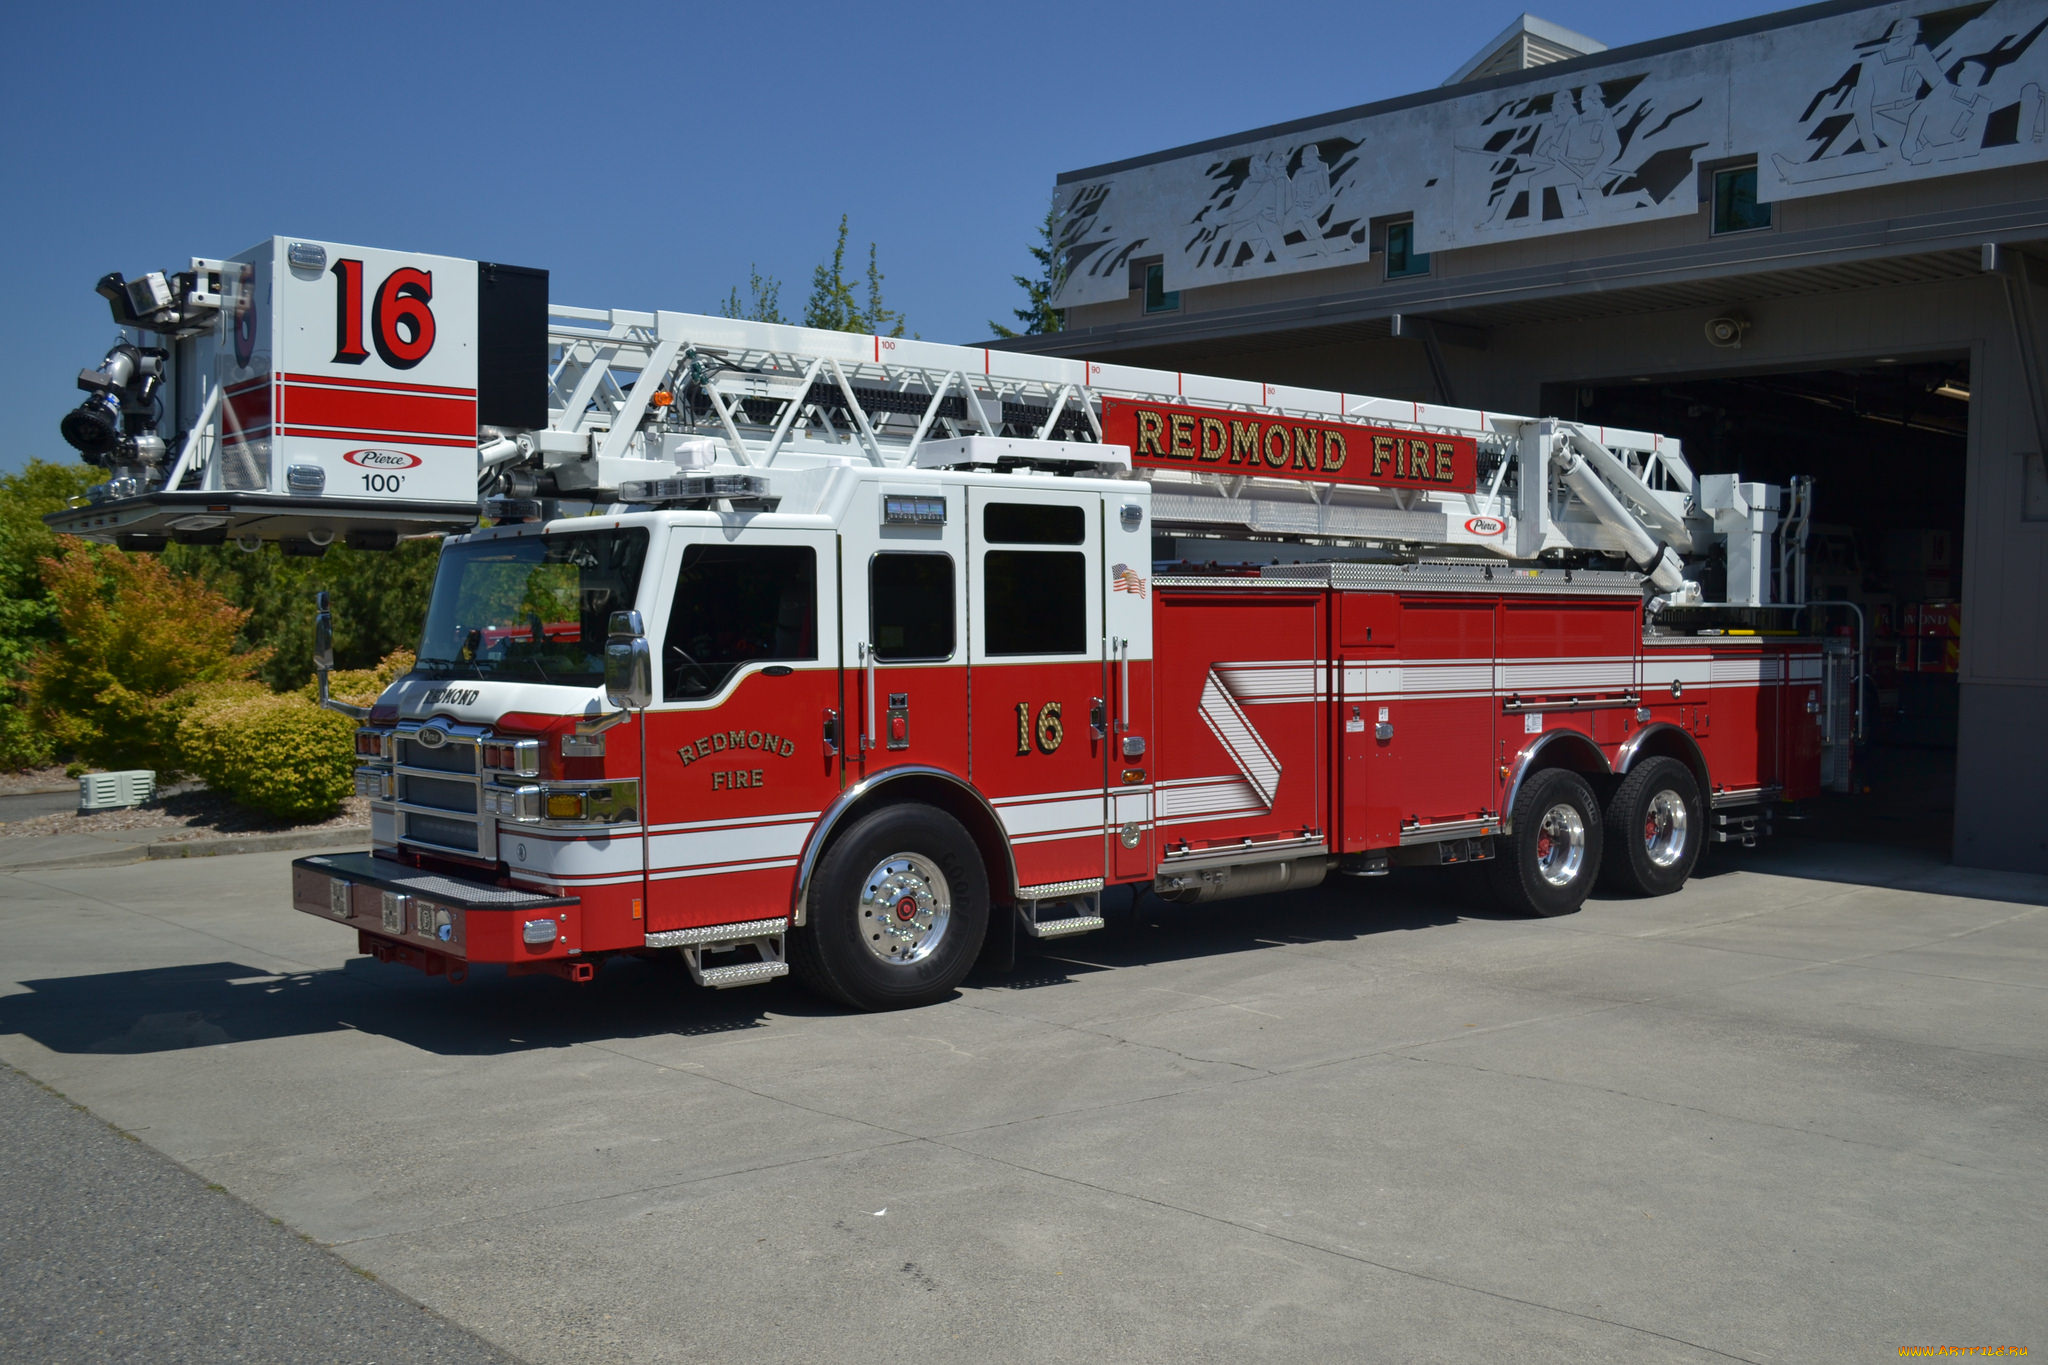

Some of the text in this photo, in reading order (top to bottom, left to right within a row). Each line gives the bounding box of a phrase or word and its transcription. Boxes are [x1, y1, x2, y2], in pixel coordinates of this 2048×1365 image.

[330, 258, 436, 370] 16
[881, 340, 896, 350] 100
[1091, 366, 1101, 374] 90
[1267, 387, 1276, 395] 80
[1417, 405, 1425, 413] 70
[1134, 410, 1455, 482] REDMOND FIRE
[361, 451, 405, 465] Pierce
[1473, 519, 1497, 531] Pierce
[1014, 701, 1063, 756] 16
[677, 730, 795, 767] REDMOND
[712, 768, 764, 791] FIRE
